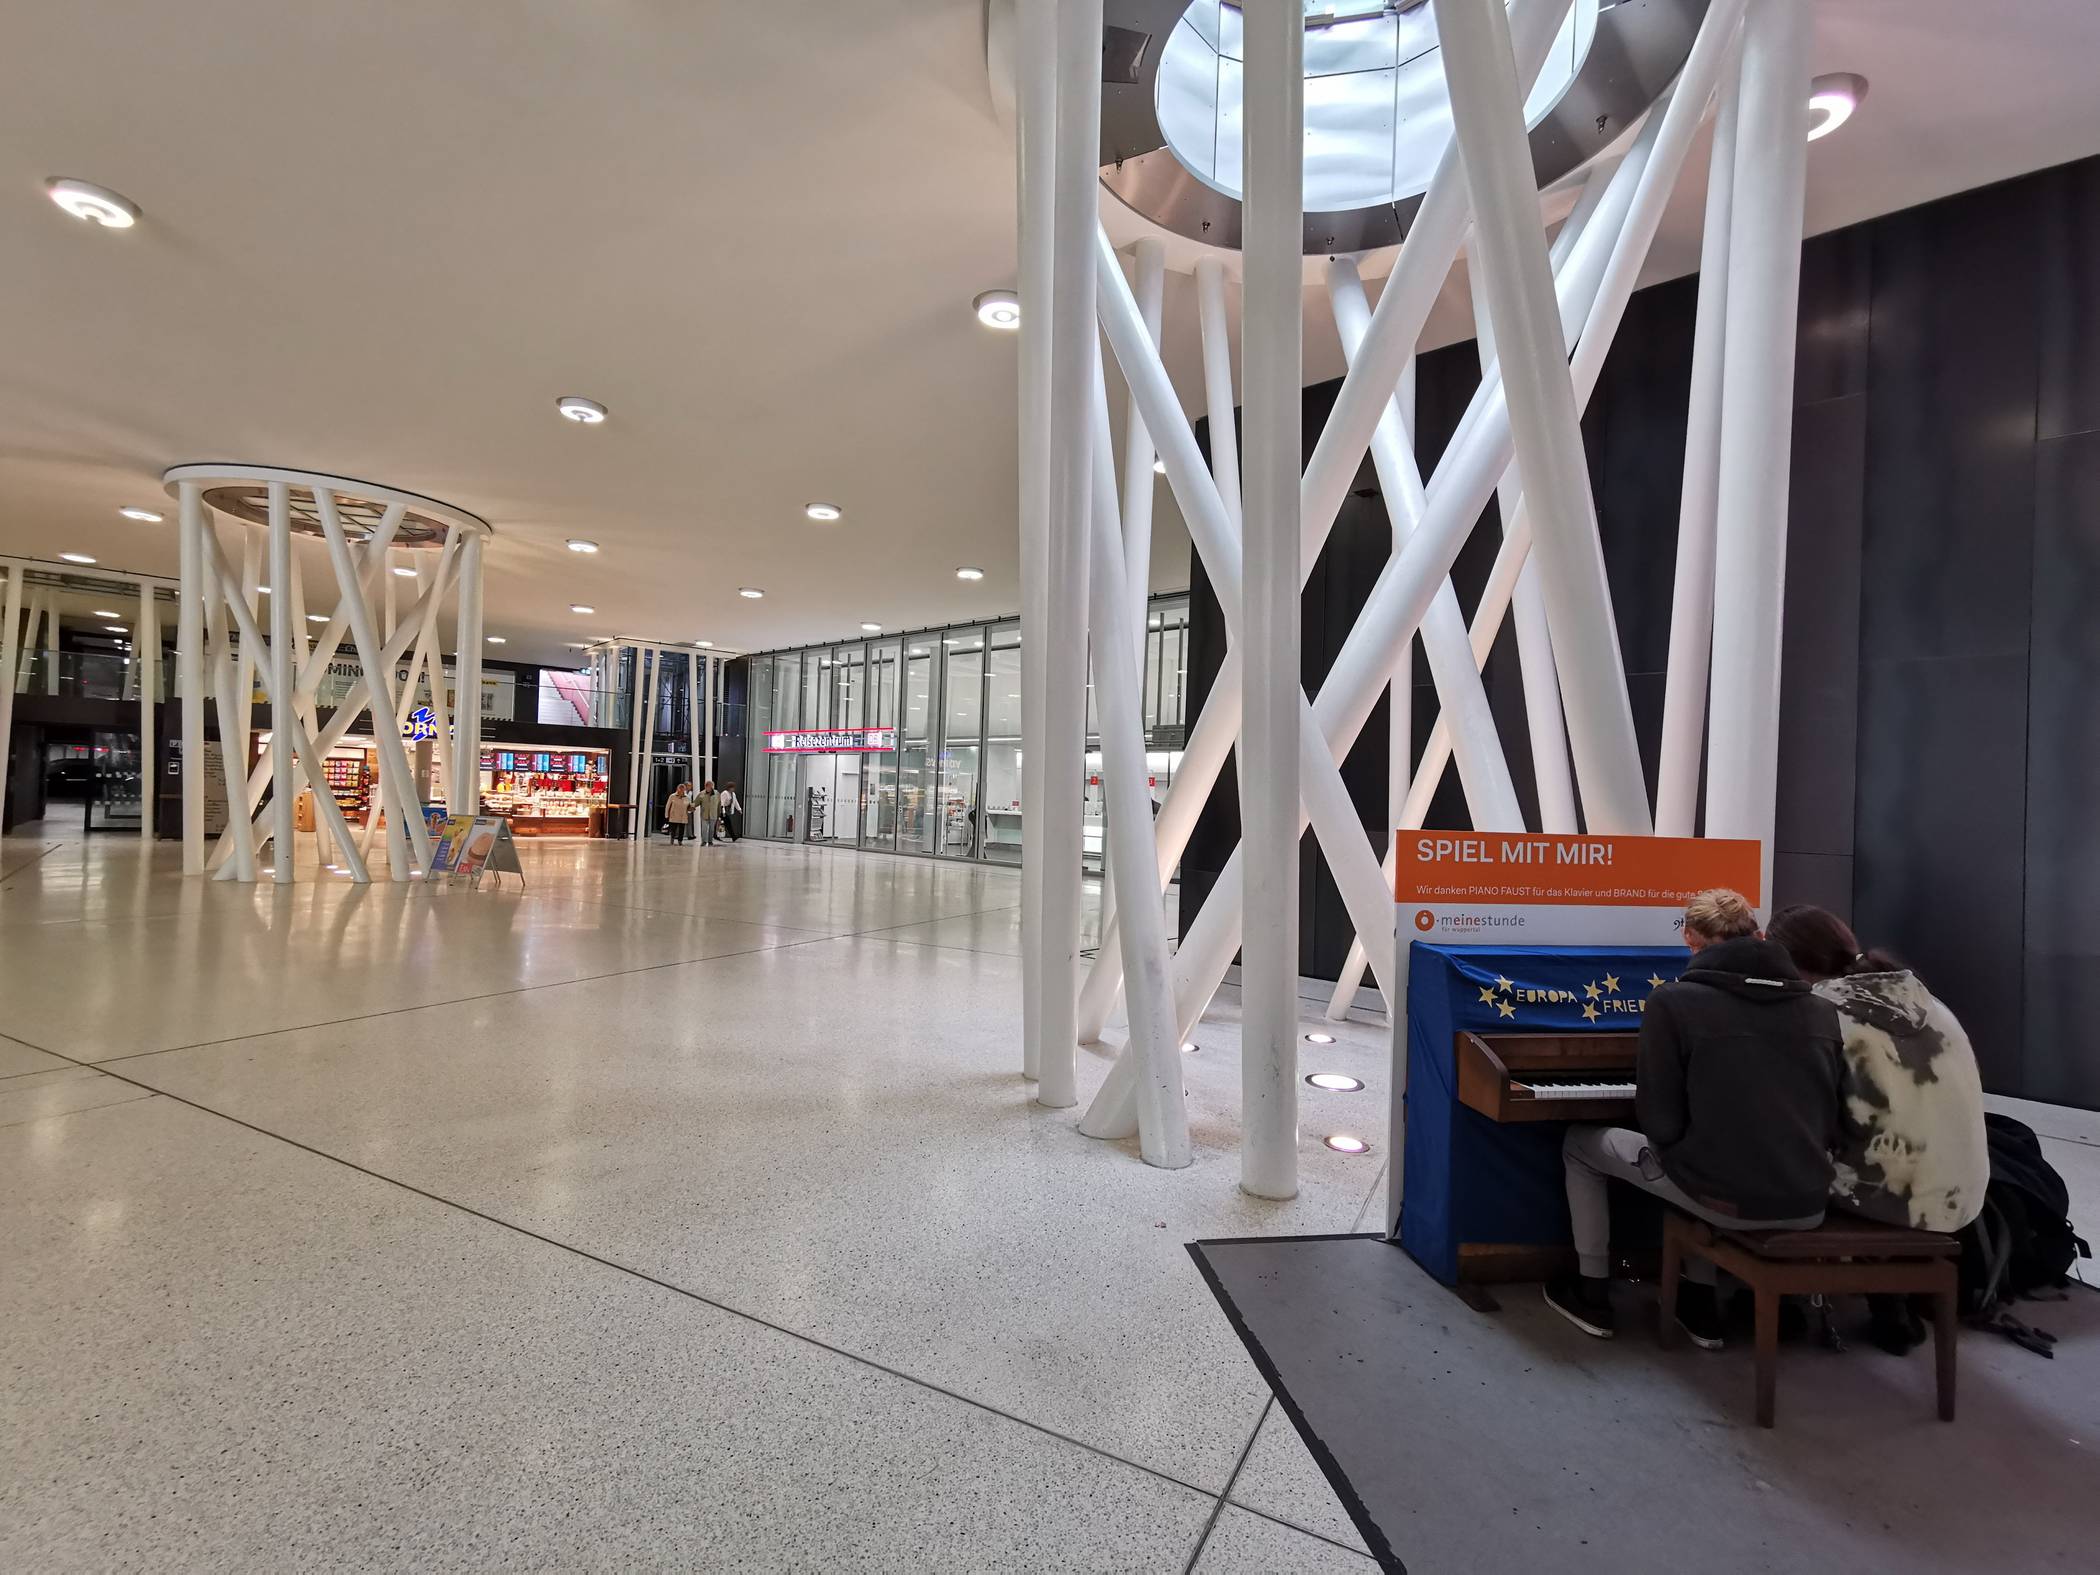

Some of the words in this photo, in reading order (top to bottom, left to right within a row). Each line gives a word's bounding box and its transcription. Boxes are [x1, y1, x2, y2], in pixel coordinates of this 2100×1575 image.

[795, 734, 851, 747] Reisezentrum
[1417, 839, 1494, 863] SPIEL
[1501, 841, 1550, 864] MIT
[1556, 843, 1613, 866] MIR!
[1416, 885, 1432, 895] Wir
[1434, 886, 1467, 896] danken
[1468, 886, 1499, 896] PIANO
[1500, 887, 1531, 897] FAUST
[1532, 886, 1544, 897] für
[1546, 887, 1563, 898] das
[1564, 887, 1593, 898] Klavier
[1595, 888, 1612, 898] und
[1613, 888, 1647, 898] BRAND
[1648, 888, 1660, 899] für
[1661, 889, 1675, 899] die
[1675, 890, 1696, 901] gute
[1441, 913, 1526, 927] meinestunde
[1516, 988, 1579, 1004] EUROPA
